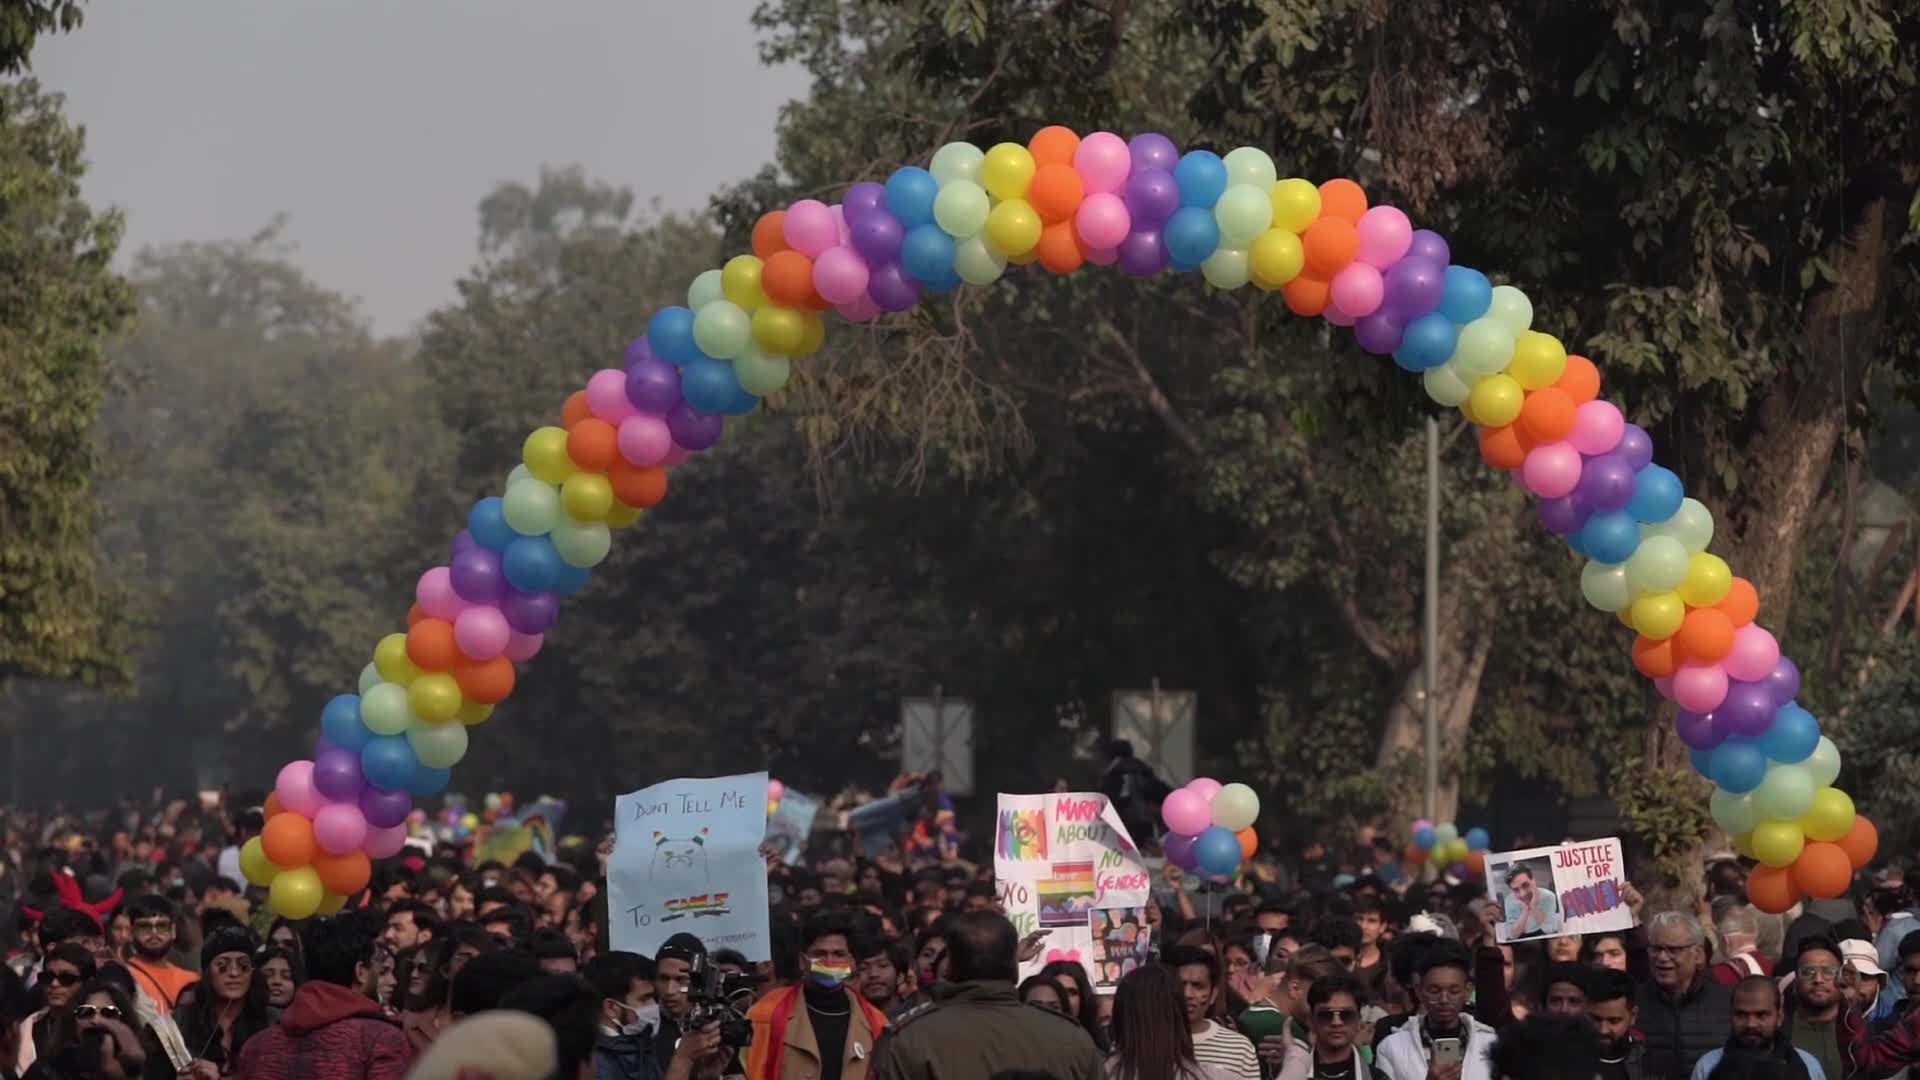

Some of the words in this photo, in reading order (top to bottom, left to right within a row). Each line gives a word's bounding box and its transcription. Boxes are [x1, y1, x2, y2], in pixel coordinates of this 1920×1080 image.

[676, 793, 712, 814] TELL
[720, 791, 746, 808] ME
[1056, 824, 1108, 844] ABOUT
[1100, 849, 1123, 867] NO
[1555, 844, 1614, 868] JUSTICE
[1586, 863, 1611, 878] FOR
[1001, 881, 1028, 904] NO
[1096, 871, 1148, 903] GENDER
